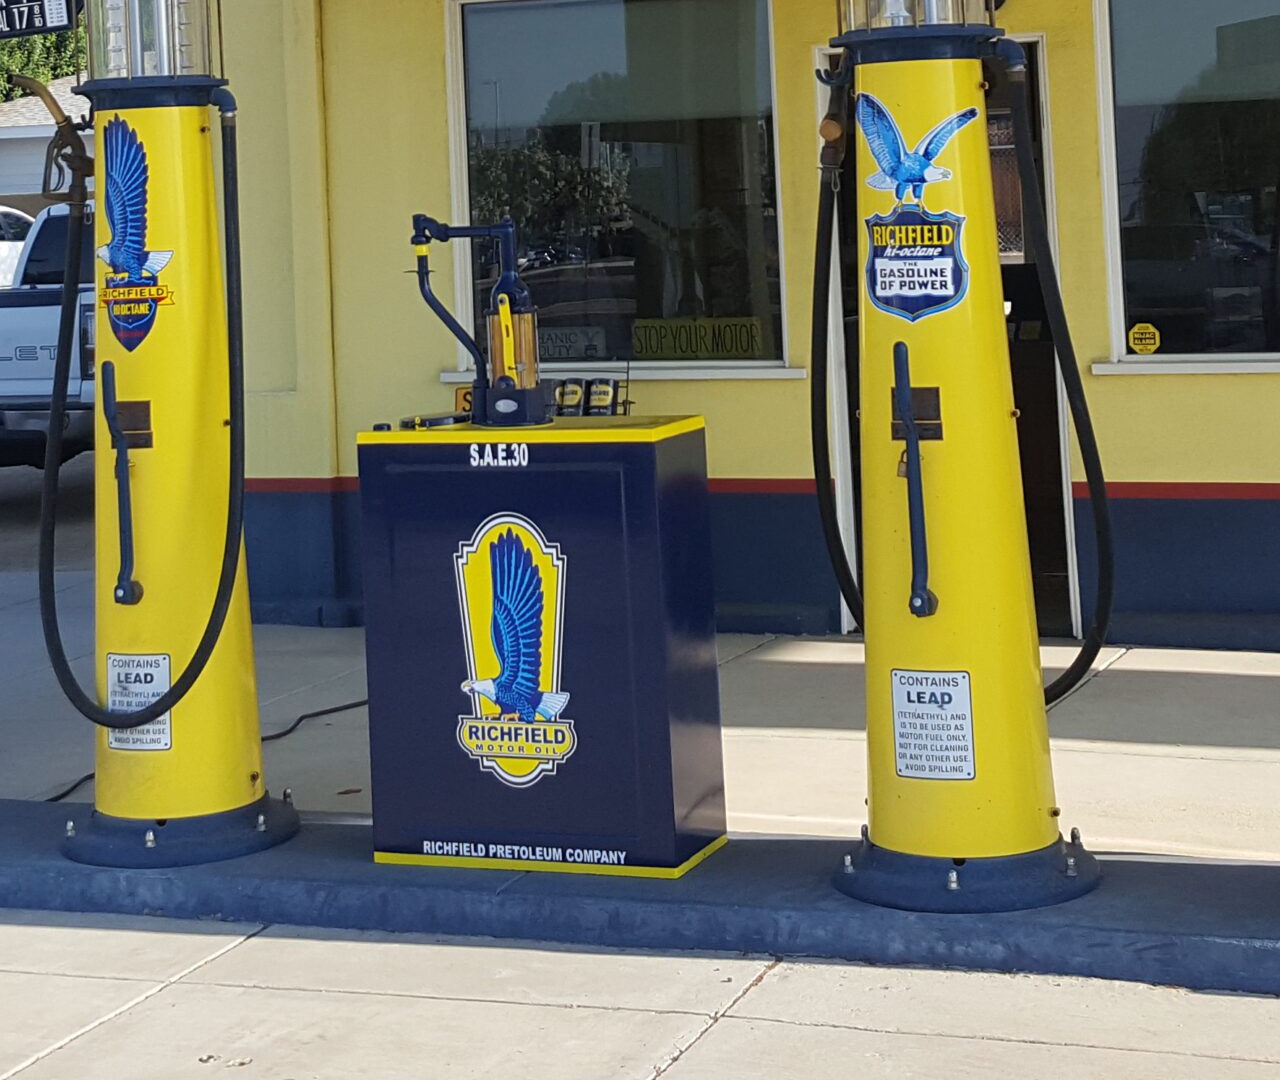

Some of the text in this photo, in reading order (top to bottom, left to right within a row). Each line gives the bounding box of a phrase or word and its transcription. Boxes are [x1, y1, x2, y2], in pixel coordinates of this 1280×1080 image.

[13, 7, 28, 29] 17
[873, 225, 953, 246] RICHFIELD
[884, 240, 942, 256] hi-octane
[880, 268, 947, 278] GASOLINE
[880, 280, 948, 290] OF POWER
[102, 288, 164, 298] RICHFIELD
[634, 324, 760, 354] STOP YOUR MOTOR
[112, 659, 160, 668] CONTAINS
[117, 672, 154, 684] LEAD
[900, 676, 959, 687] CONTAINS
[907, 691, 952, 704] LEAD
[469, 725, 566, 744] RICHFIELD
[899, 732, 923, 740] MOTOR
[476, 744, 525, 753] MOTOR
[914, 743, 928, 751] FOR
[930, 744, 968, 752] CLEANING
[898, 752, 907, 760] OR
[925, 754, 951, 762] OTHER
[905, 764, 964, 773] AVOID SPILLING
[424, 841, 626, 864] RICHFIELD PRETOLEUM COMPANY
